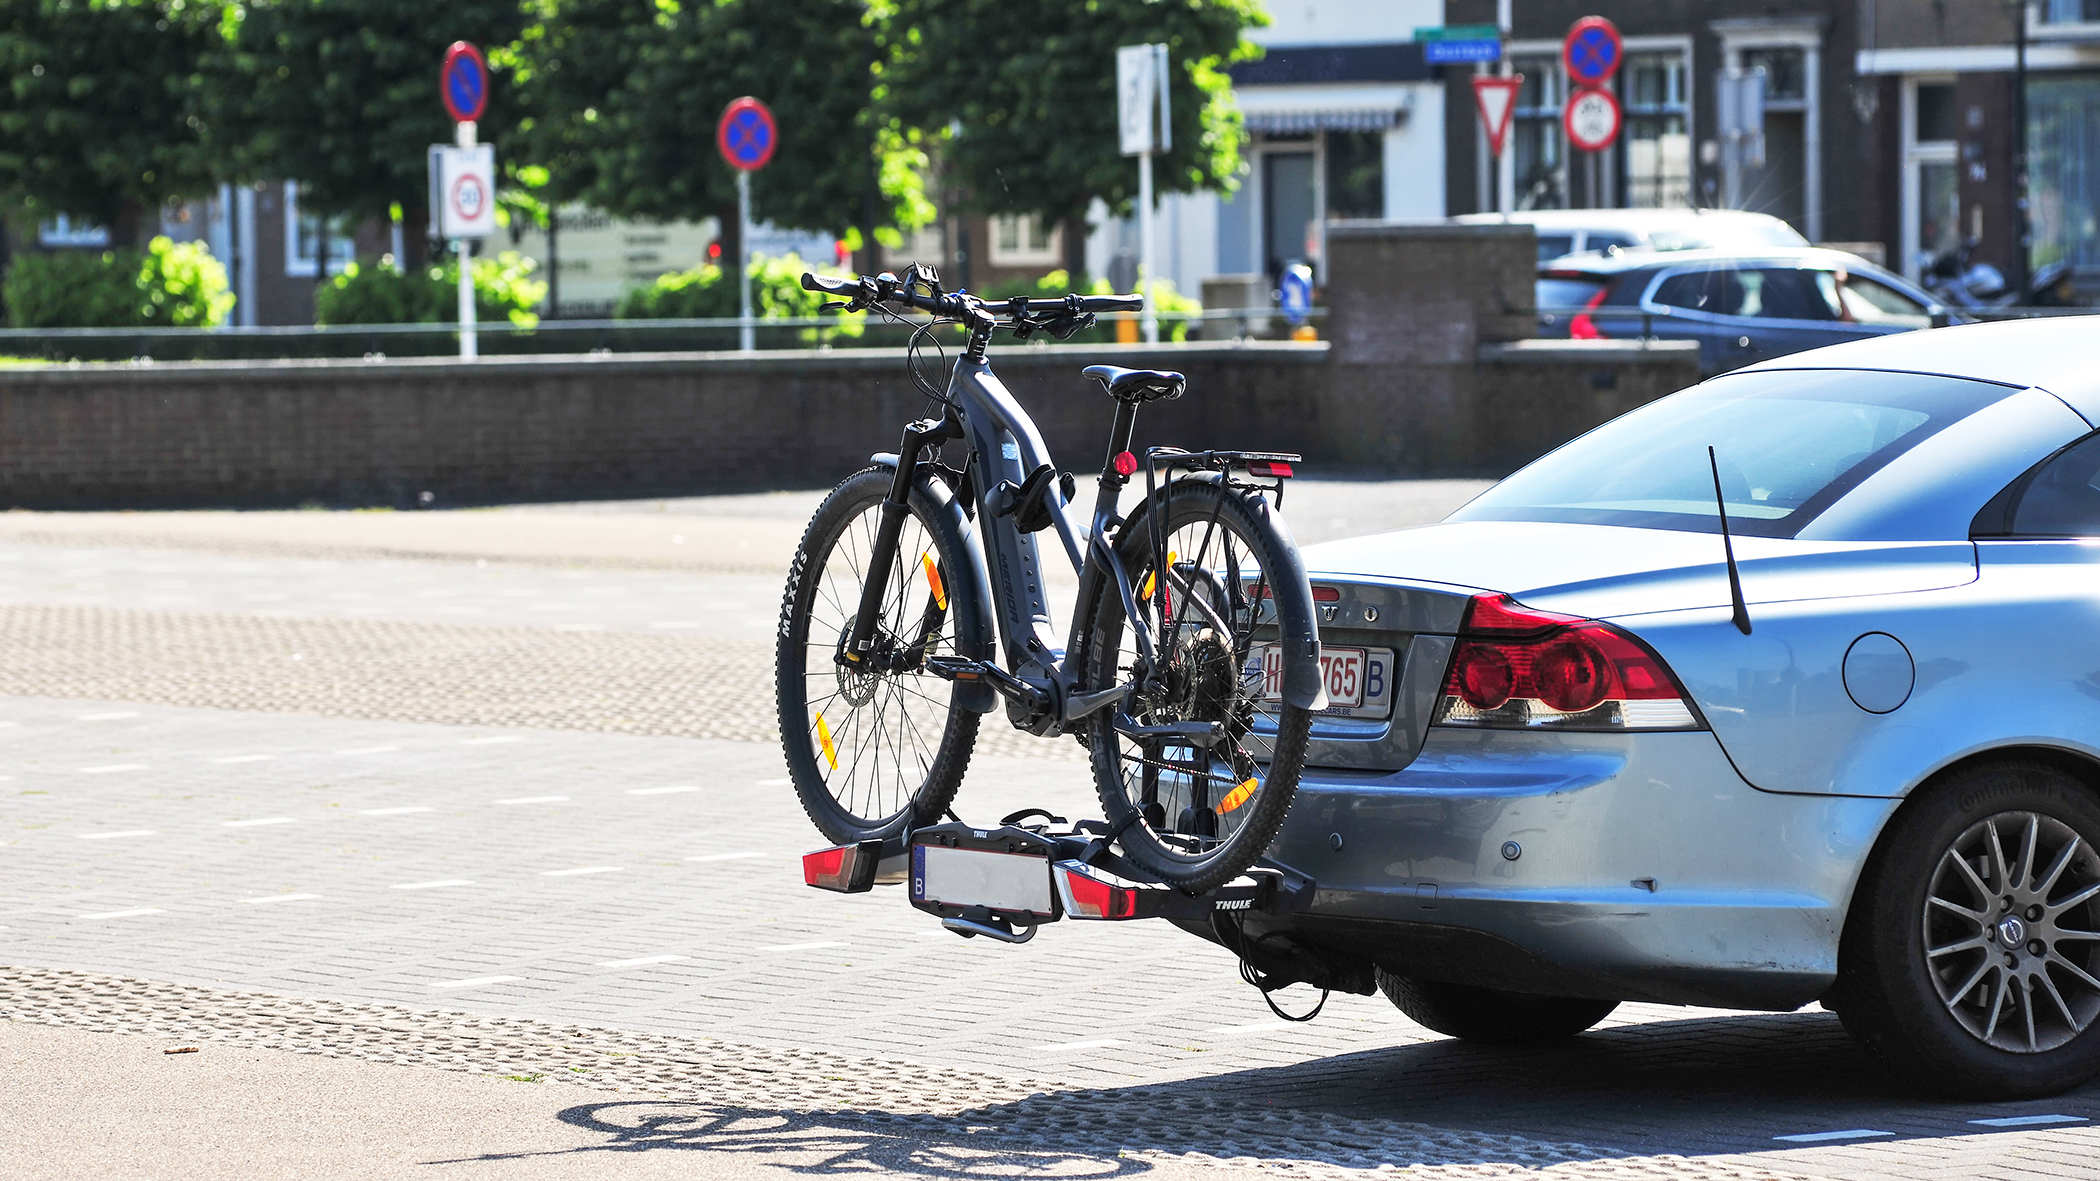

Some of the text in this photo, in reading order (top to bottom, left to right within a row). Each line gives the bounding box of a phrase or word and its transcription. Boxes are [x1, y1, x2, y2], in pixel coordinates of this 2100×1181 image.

[782, 550, 808, 638] MAXXIS
[1001, 552, 1019, 625] MERIDA
[1366, 660, 1384, 698] B
[973, 830, 988, 839] THULE
[915, 877, 923, 895] B
[1215, 899, 1252, 910] THULE
